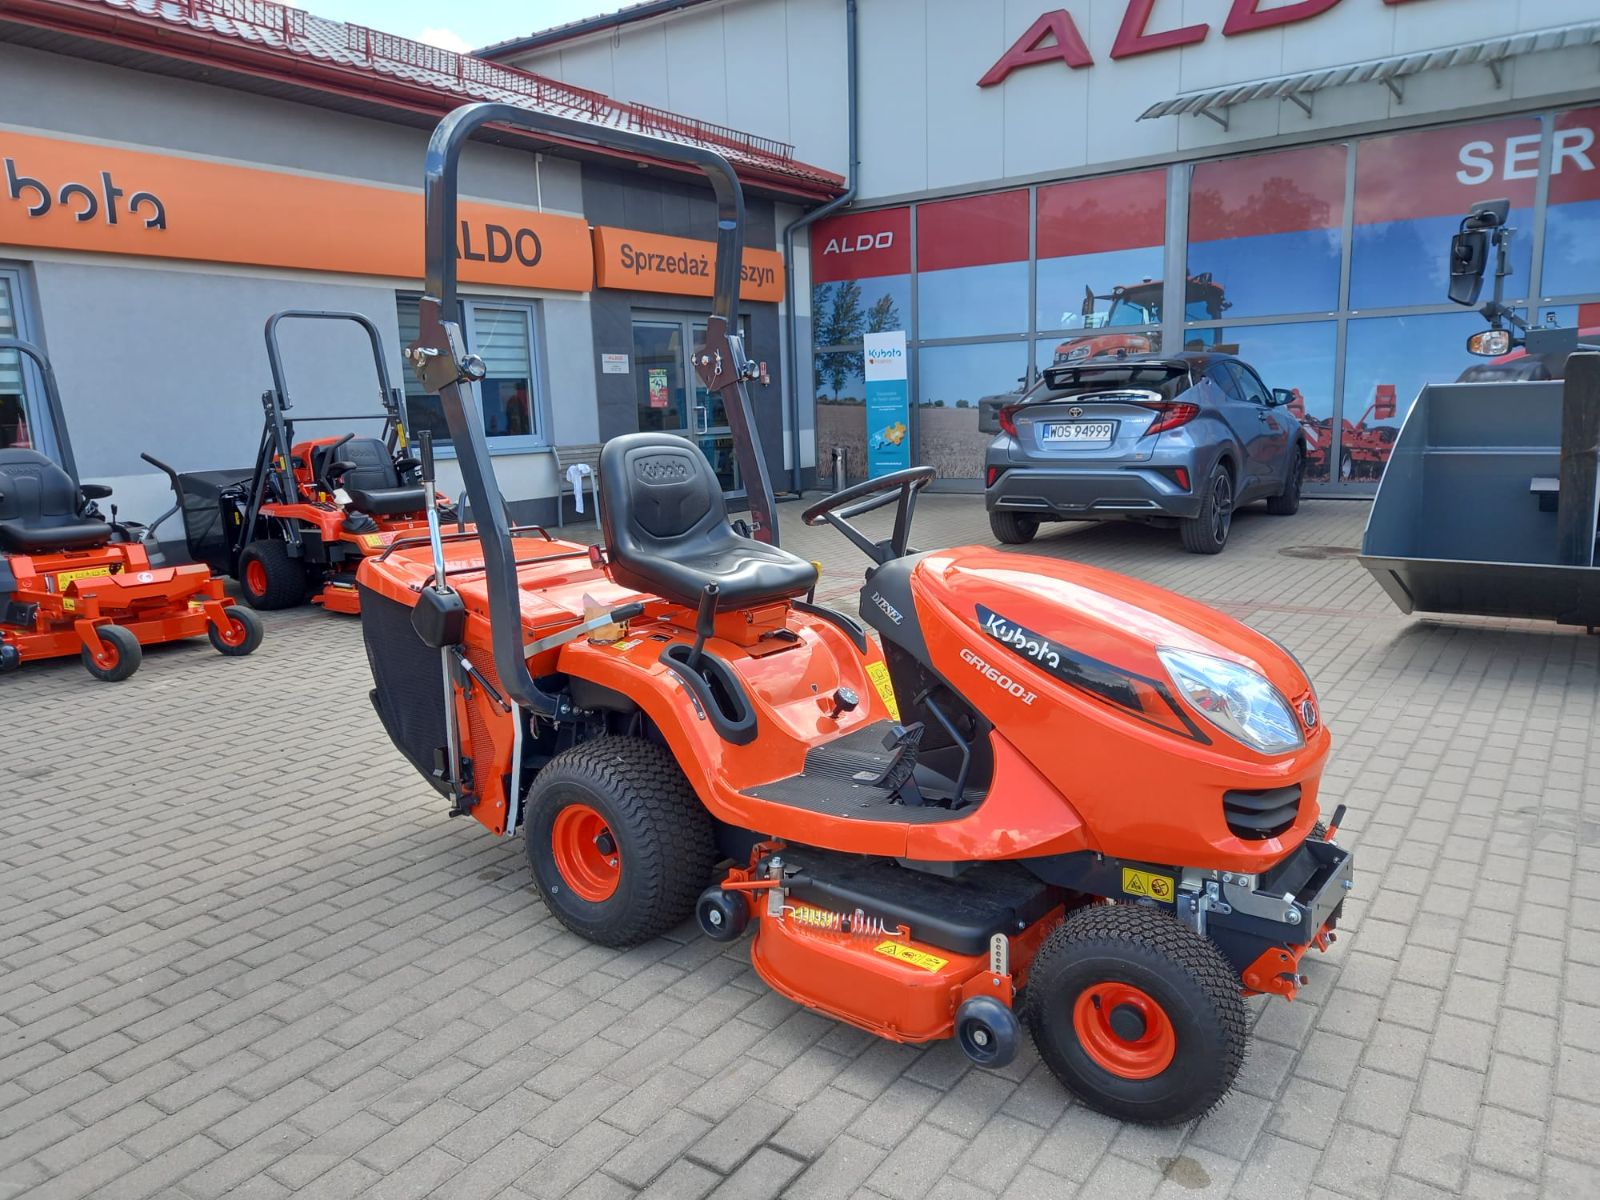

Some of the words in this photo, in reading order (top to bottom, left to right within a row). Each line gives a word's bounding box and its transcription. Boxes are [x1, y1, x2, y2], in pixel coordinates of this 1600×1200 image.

[1456, 127, 1596, 185] SER
[456, 220, 542, 267] LDO
[620, 243, 709, 277] Sprzedaż
[823, 231, 893, 255] ALDO
[869, 348, 902, 358] Kubota
[1050, 425, 1072, 438] WOS
[1074, 425, 1110, 438] 94999
[871, 591, 904, 626] DIESEL
[986, 613, 1060, 669] Kubota
